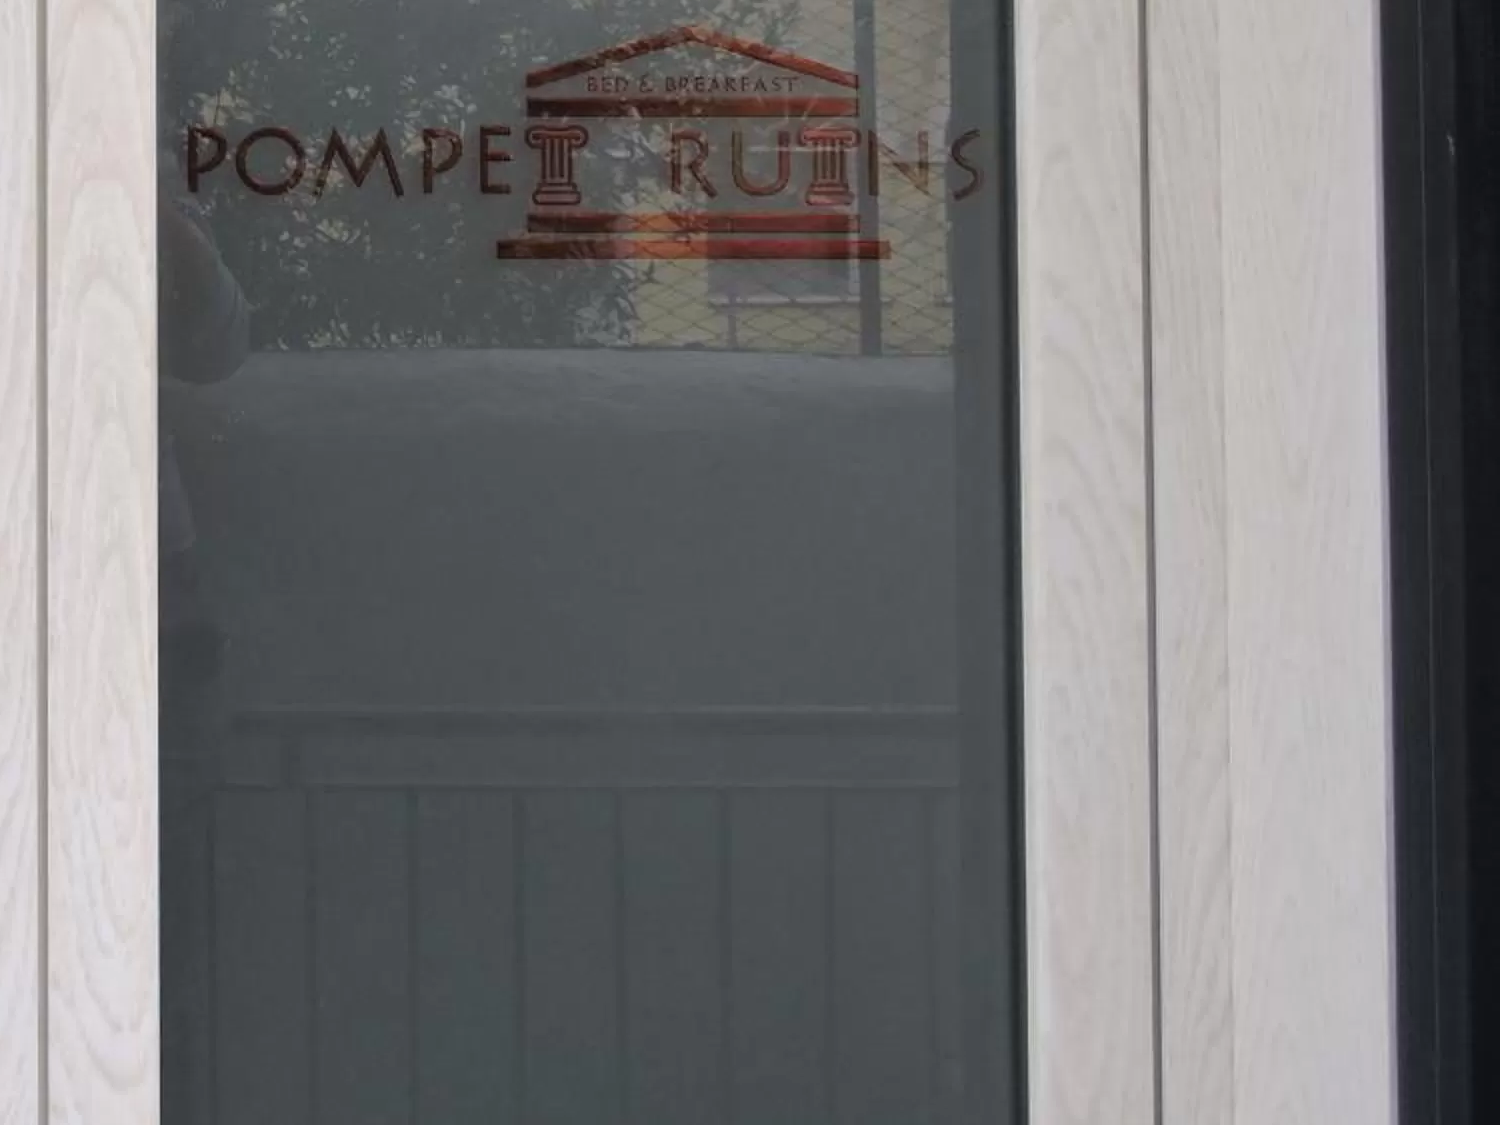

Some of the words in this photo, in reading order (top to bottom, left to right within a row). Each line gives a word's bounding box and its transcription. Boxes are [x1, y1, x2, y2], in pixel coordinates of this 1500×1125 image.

[587, 76, 631, 94] BED
[639, 76, 657, 94] &
[665, 75, 800, 94] BREAKFAST
